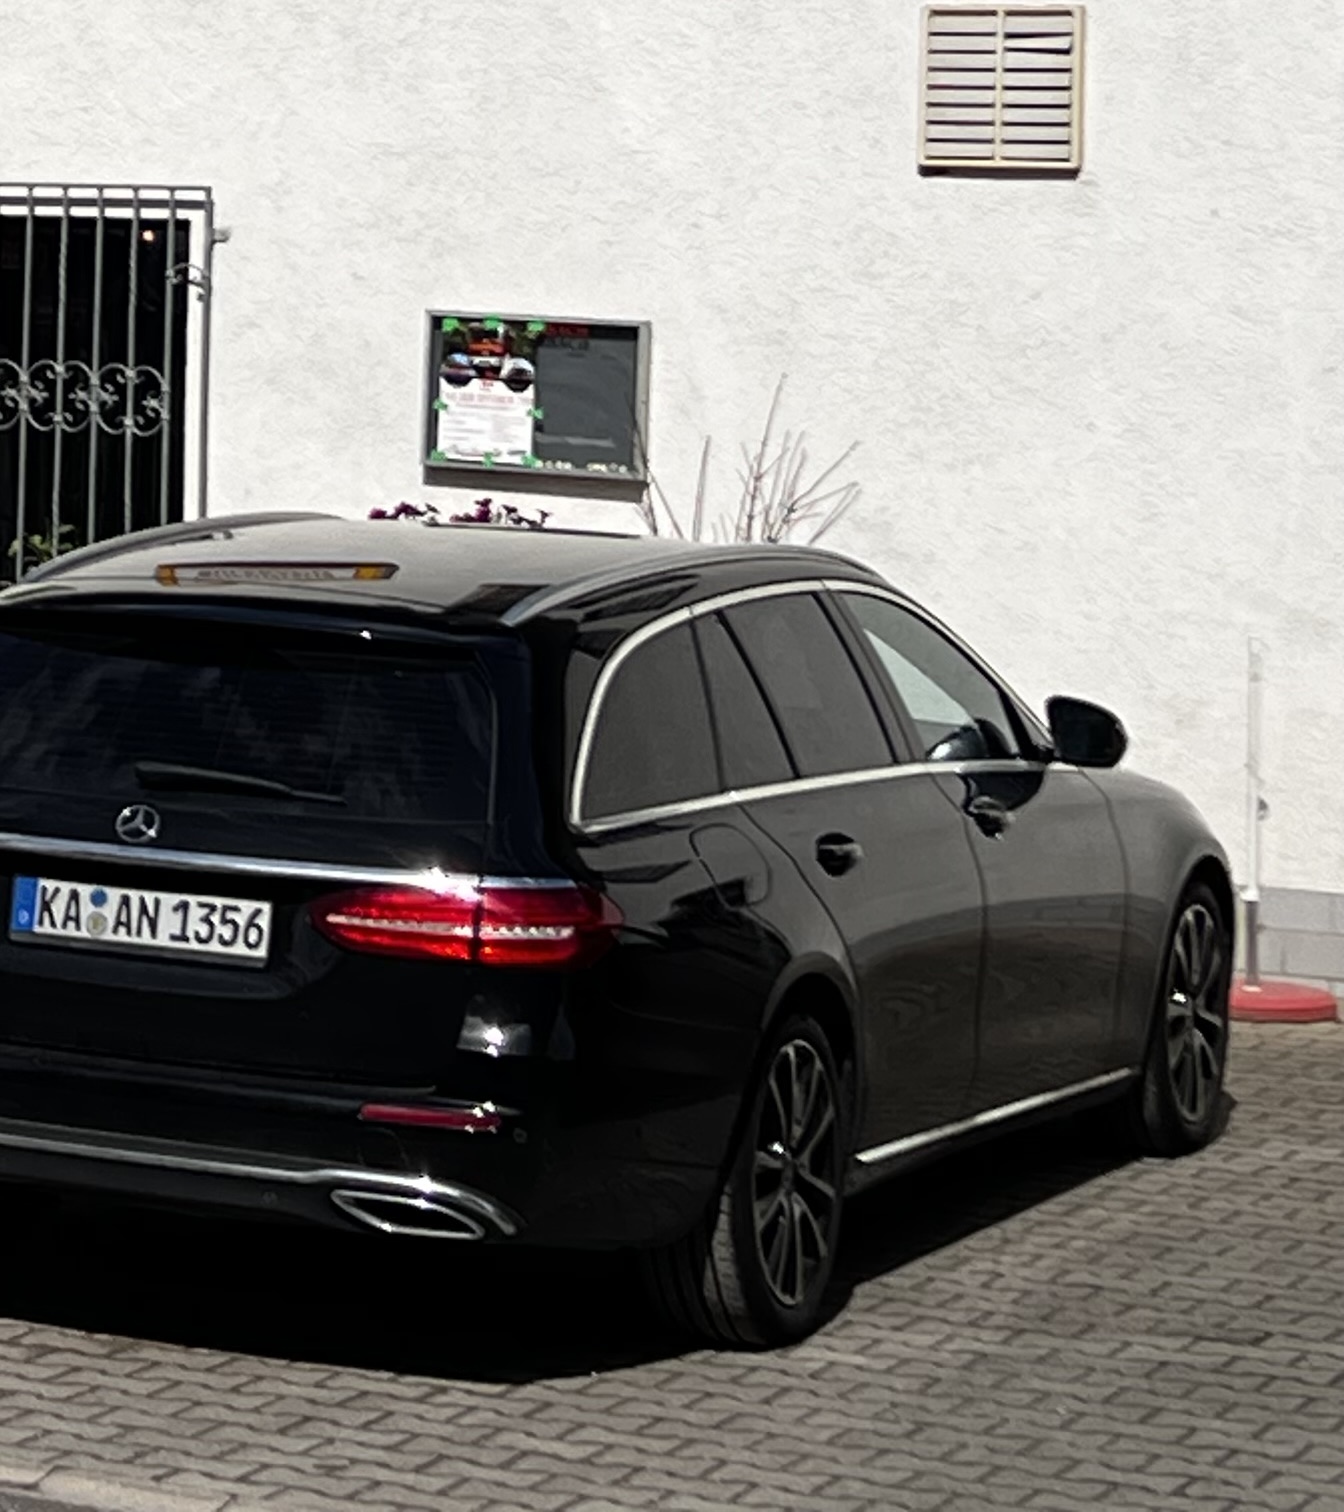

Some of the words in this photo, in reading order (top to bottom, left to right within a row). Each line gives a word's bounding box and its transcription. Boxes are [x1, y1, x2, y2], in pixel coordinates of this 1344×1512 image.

[38, 885, 81, 932] KA
[112, 894, 160, 940] AN
[169, 899, 264, 950] 1356
